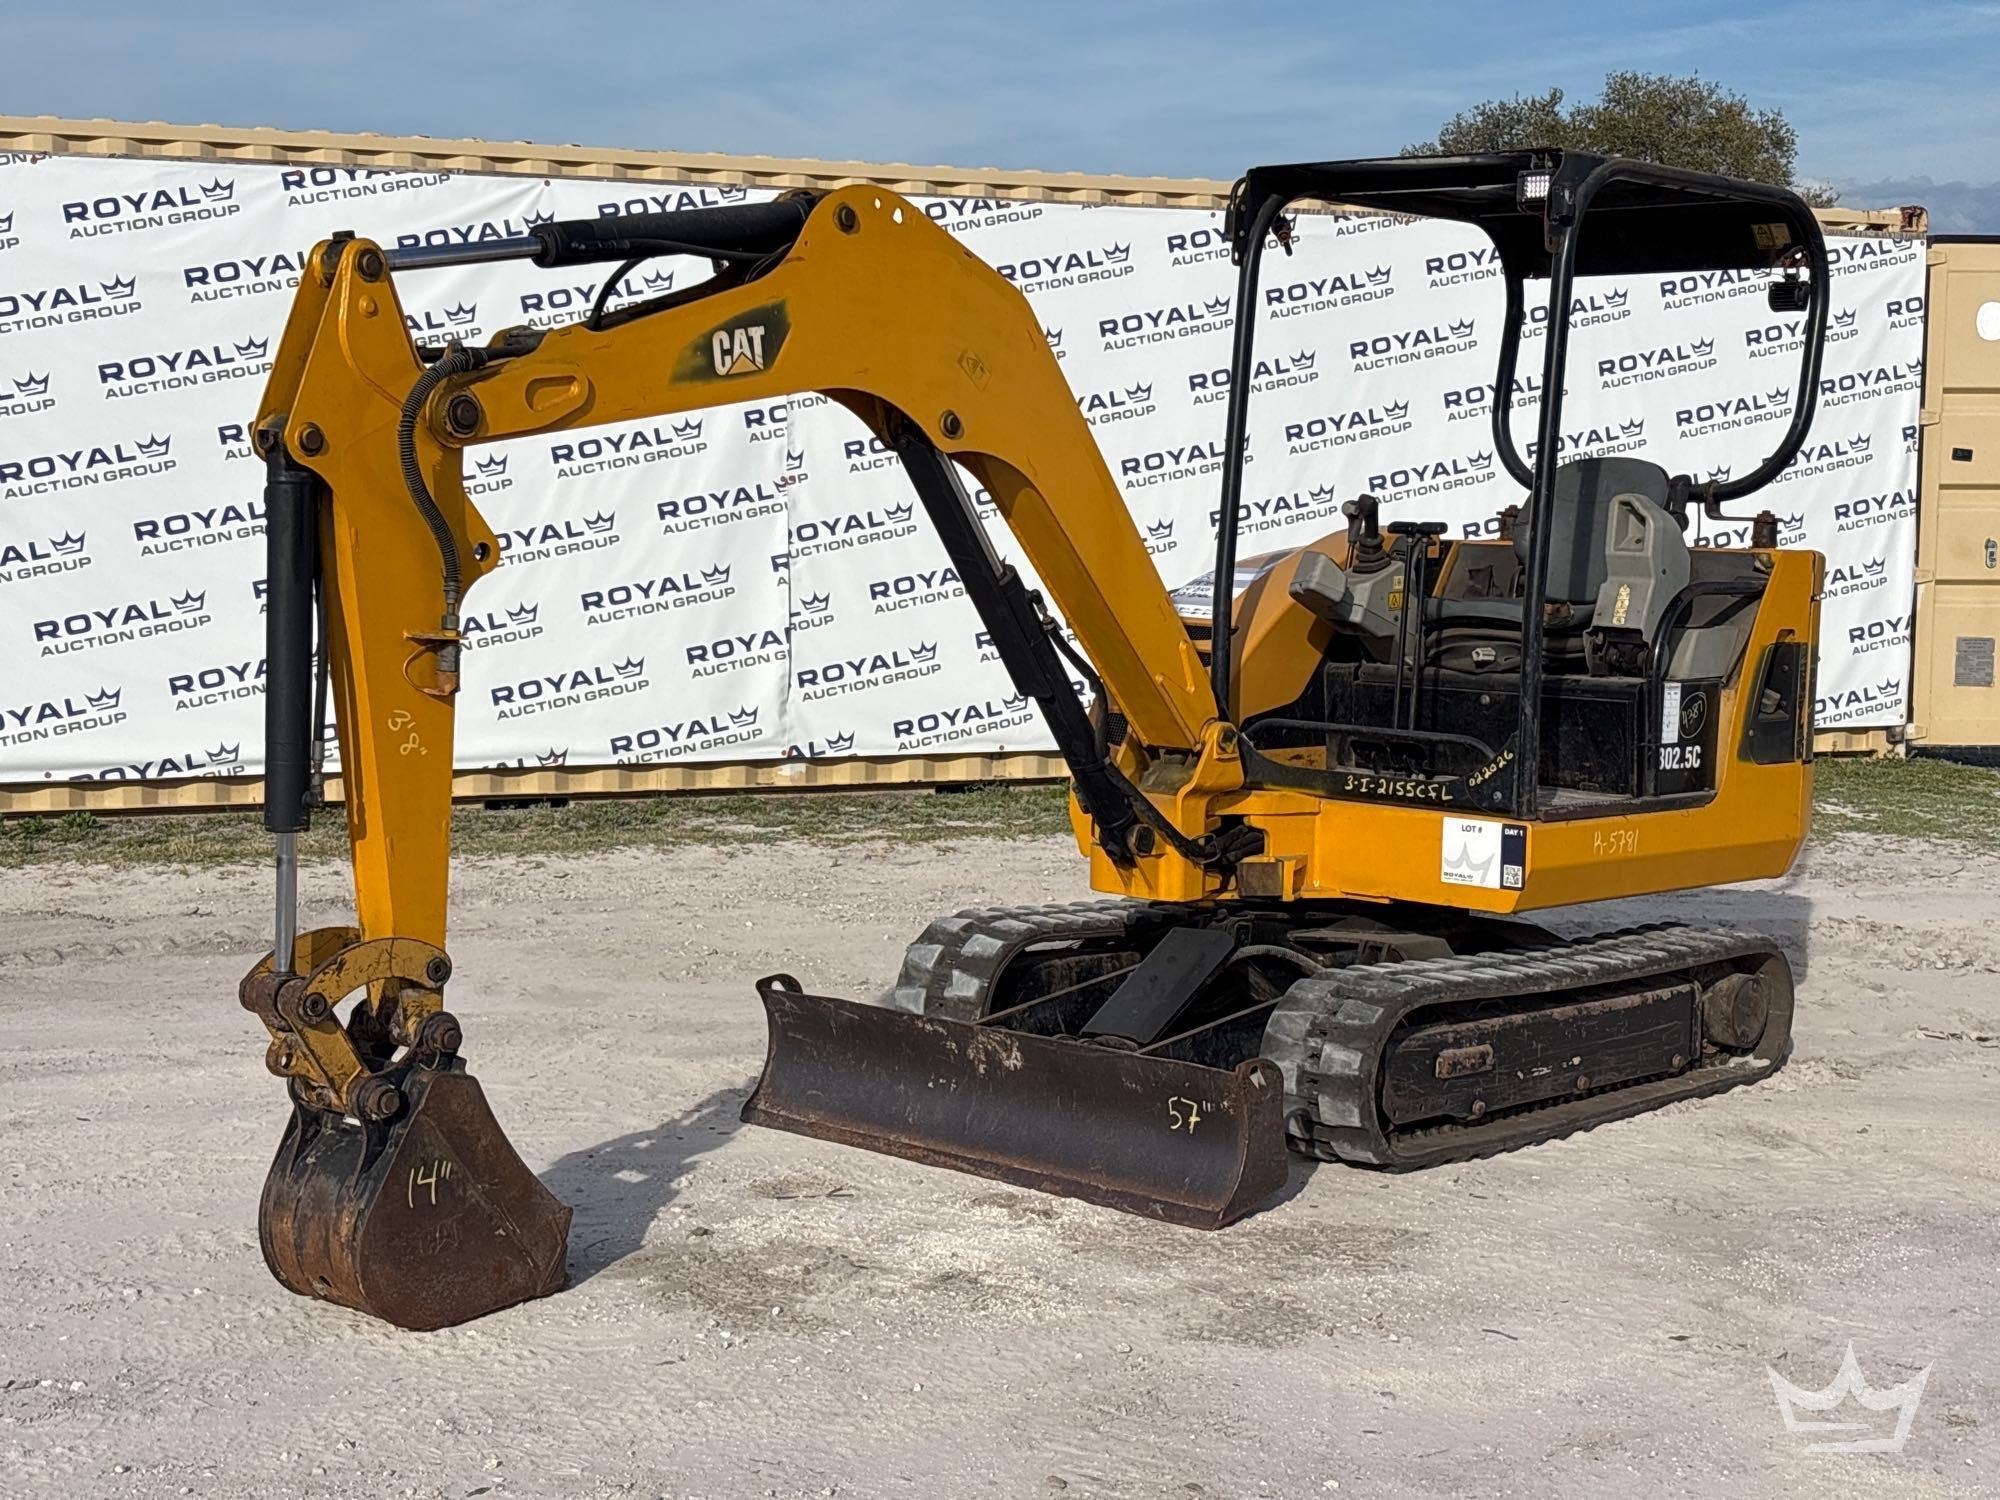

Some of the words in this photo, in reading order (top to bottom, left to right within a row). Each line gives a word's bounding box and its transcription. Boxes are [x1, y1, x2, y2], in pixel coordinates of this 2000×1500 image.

[62, 186, 202, 224] ROYAL
[288, 183, 378, 207] AUCTION
[381, 172, 451, 193] GROUP
[69, 215, 164, 240] AUCTION
[167, 203, 241, 225] GROUP
[942, 217, 982, 233] TION
[984, 207, 1043, 227] GROUP
[1336, 216, 1404, 237] AUCTION
[1167, 228, 1229, 253] ROY
[1827, 240, 1893, 265] OYAL
[1171, 248, 1231, 267] AUCTIO
[1425, 247, 1502, 276] ROYA
[1828, 263, 1868, 278] CTION
[1869, 253, 1918, 269] GROUP
[190, 280, 282, 304] AUCTION
[1019, 274, 1074, 294] CTION
[1077, 265, 1135, 284] GROUP
[1265, 273, 1366, 306] ROYAL
[1428, 268, 1497, 289] AUCTION
[1660, 269, 1751, 298] ROYAL
[0, 284, 102, 318] OYAL
[1269, 298, 1338, 320] AUCTION
[1340, 287, 1395, 306] GROUP
[1663, 291, 1726, 311] AUCTION
[0, 310, 64, 334] CTION
[67, 301, 143, 323] GROUP
[1099, 304, 1205, 338] ROYAL
[1580, 309, 1631, 327] GROUP
[1889, 315, 1926, 330] AUCT
[712, 325, 766, 376] CAT
[1103, 326, 1175, 352] AUCTION
[1178, 318, 1234, 337] GROUP
[1350, 327, 1450, 359] ROYAL
[98, 345, 235, 384] ROYAL
[1353, 351, 1422, 373] AUCTION
[1424, 339, 1478, 359] GROUP
[1598, 345, 1691, 377] ROYAL
[105, 374, 198, 400] AUCTION
[202, 361, 274, 383] GROUP
[1189, 358, 1290, 392] ROAL
[1264, 371, 1319, 391] GROUP
[1601, 369, 1666, 390] AUCTION
[1667, 358, 1718, 377] GROUP
[1820, 365, 1907, 397] ROYAL
[788, 395, 829, 412] TION
[1099, 404, 1156, 424] GROUP
[1675, 395, 1767, 427] ROYAL
[1822, 388, 1882, 409] AUCTION
[1285, 408, 1384, 442] ROYAL
[1289, 433, 1357, 456] AUCTION
[1359, 421, 1413, 441] GROUP
[1679, 418, 1742, 440] AUCTION
[1744, 407, 1792, 425] GROUP
[550, 427, 673, 465] ROYAL
[557, 453, 640, 480] AUCTION
[643, 442, 708, 463] GROUP
[1120, 440, 1226, 477] ROYAL
[1596, 438, 1648, 458] GROUP
[0, 443, 137, 483] ROYAL
[849, 455, 900, 474] AUCTI
[1125, 466, 1197, 490] AUCTION
[1368, 458, 1469, 493] ROYAL
[1769, 464, 1824, 485] UCTION
[1826, 453, 1873, 472] GROUP
[4, 472, 100, 500] AUCTION
[103, 459, 177, 483] GROUP
[1442, 471, 1497, 491] GROUP
[657, 483, 775, 520] ROYAL
[1284, 505, 1338, 527] GROUP
[133, 501, 266, 542] ROYAL
[497, 521, 585, 552] OYAL
[663, 510, 743, 535] AUCTION
[788, 511, 886, 544] OYAL
[1837, 512, 1898, 533] AUCTION
[141, 530, 233, 557] AUCTION
[495, 548, 552, 569] CTION
[554, 534, 621, 557] GROUP
[788, 536, 855, 559] UCTION
[857, 525, 918, 546] GROUP
[1779, 532, 1807, 547] OUP
[17, 556, 92, 581] GROUP
[869, 567, 961, 601] ROYA
[580, 573, 703, 611] ROYAL
[874, 589, 949, 615] AUCTION
[1841, 577, 1888, 595] GROUP
[33, 600, 173, 642] ROYAL
[586, 600, 670, 626] AUCTION
[672, 586, 736, 609] GROUP
[40, 629, 135, 657] AUCTION
[138, 613, 212, 639] GROUP
[476, 625, 544, 650] GROUP
[1848, 614, 1911, 644] ROY
[691, 653, 771, 679] AUCTION
[797, 650, 910, 689] ROYAL
[175, 682, 266, 712] AUCTION
[490, 666, 615, 707] ROYAL
[801, 677, 880, 703] AUCTION
[881, 663, 942, 685] GROUP
[0, 697, 88, 731] YAL
[496, 692, 581, 720] AUCTION
[584, 679, 650, 702] GROUP
[1814, 687, 1878, 715] OYAL
[1814, 710, 1853, 727] CTION
[1855, 697, 1903, 717] GROUP
[0, 727, 50, 748] TION
[52, 711, 128, 737] GROUP
[610, 715, 731, 755] ROYAL
[893, 699, 1003, 739] ROYAL
[897, 727, 973, 753] AUCTION
[975, 713, 1034, 735] GROUP
[616, 742, 697, 766] AUCTION
[699, 727, 763, 751] GROUP
[1461, 824, 1477, 834] LOT
[1504, 827, 1519, 837] DAY
[1519, 829, 1525, 837] 1
